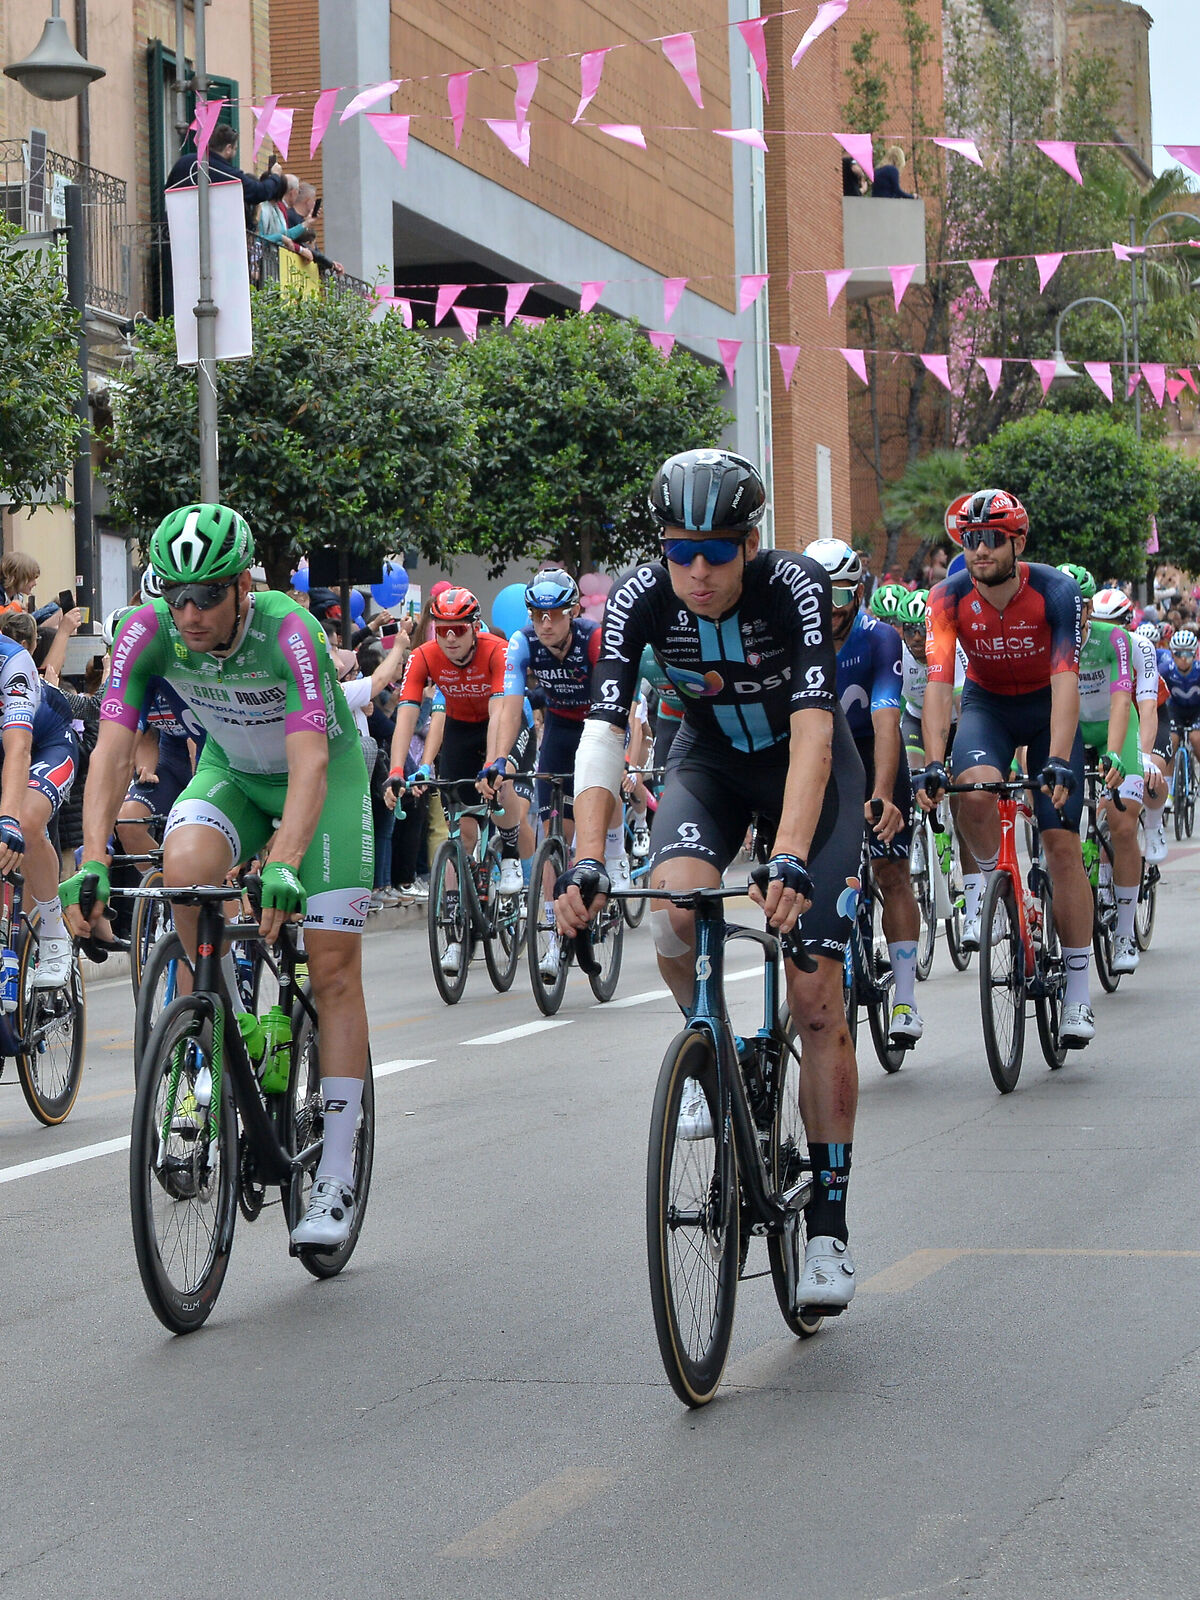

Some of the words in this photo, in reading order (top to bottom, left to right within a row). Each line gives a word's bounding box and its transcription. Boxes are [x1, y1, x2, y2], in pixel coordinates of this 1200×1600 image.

[769, 558, 825, 647] youfone
[604, 567, 657, 663] youfone
[670, 625, 698, 633] SCOTT
[1073, 595, 1083, 664] GRENADIER
[666, 636, 699, 644] SHIMANO
[975, 637, 1035, 650] INEOS
[112, 622, 148, 678] FAIZANE
[1137, 641, 1155, 679] Cofidis
[290, 640, 319, 701] FAIZANE
[192, 685, 231, 703] GREEN
[234, 687, 286, 706] PROJECT
[439, 683, 492, 693] ARKEA
[790, 690, 835, 702] SCOTT
[105, 702, 124, 714] FTC
[589, 702, 631, 717] SCOTT
[659, 841, 717, 857] SCOTT
